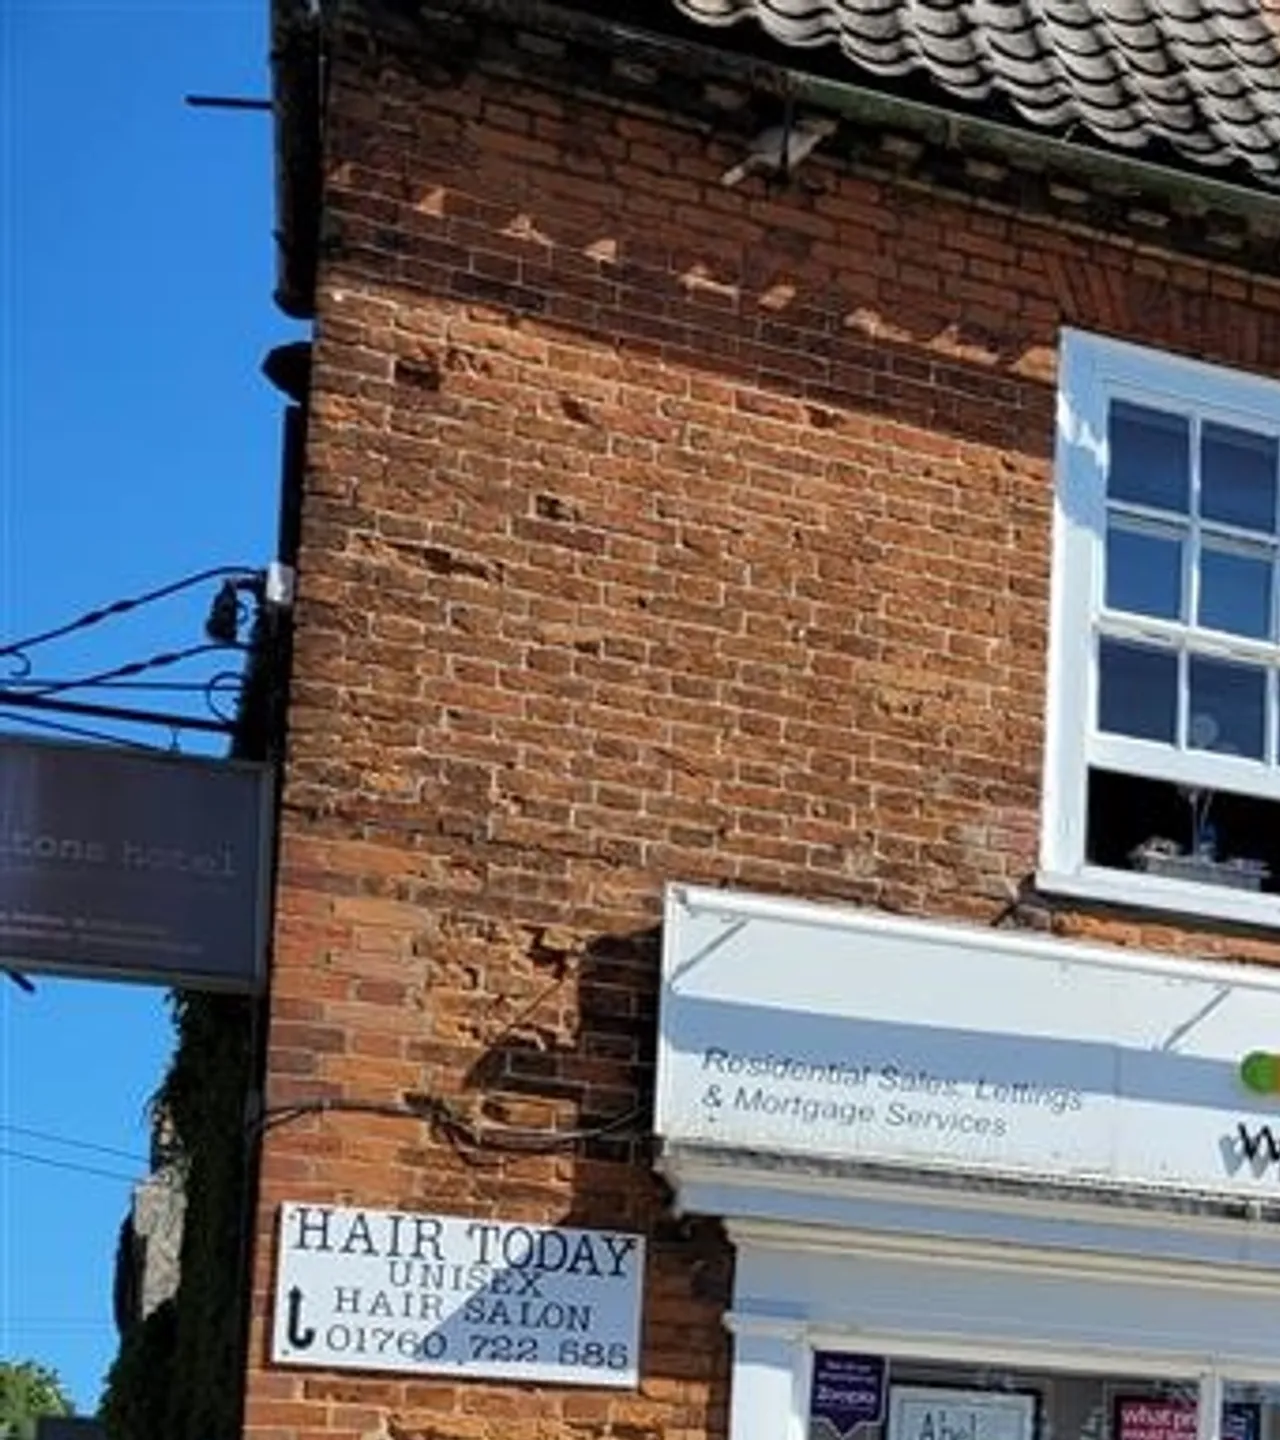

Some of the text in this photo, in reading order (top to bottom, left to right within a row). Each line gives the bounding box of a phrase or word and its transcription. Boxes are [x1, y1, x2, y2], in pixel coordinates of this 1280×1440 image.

[702, 1046, 871, 1086] Residential
[974, 1076, 1081, 1114] Lettings
[701, 1084, 1008, 1138] & Mortgage Services
[291, 1208, 638, 1278] HAIR TODAY
[388, 1260, 545, 1298] UNISEX
[334, 1286, 592, 1332] HAIR SALON
[325, 1324, 448, 1359] 01760
[469, 1334, 539, 1363] 722
